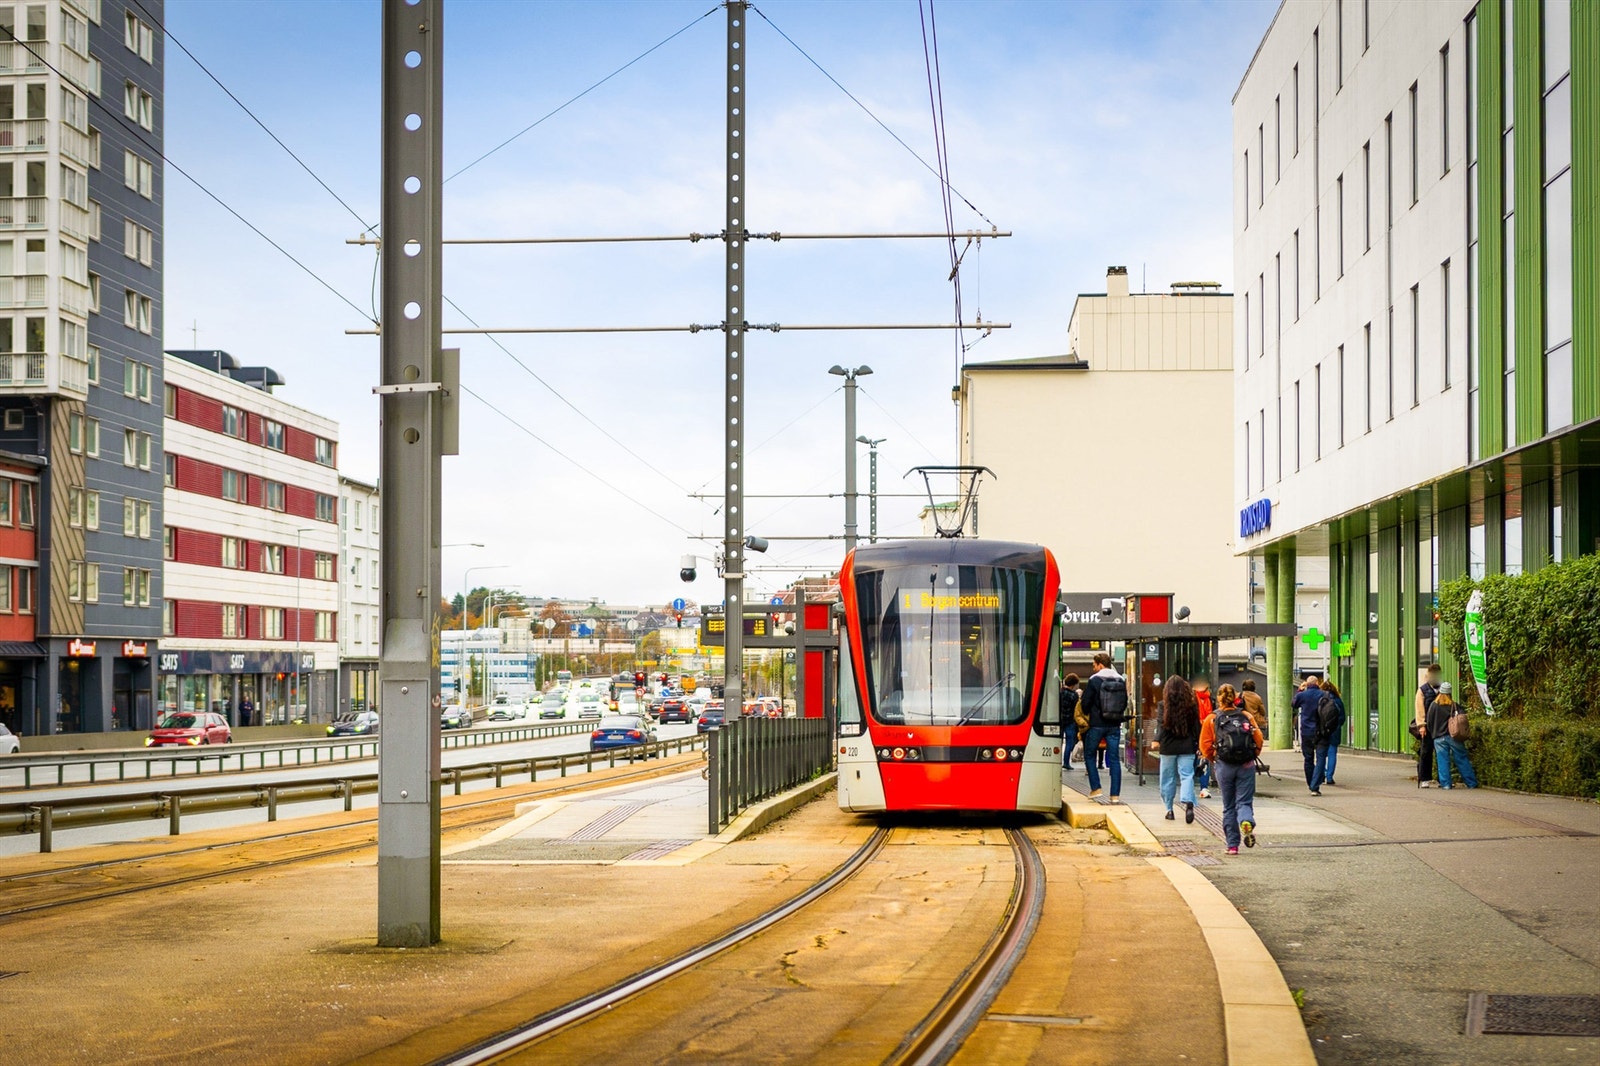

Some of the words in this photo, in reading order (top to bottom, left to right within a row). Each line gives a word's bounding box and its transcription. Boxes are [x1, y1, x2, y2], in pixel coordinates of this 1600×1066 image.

[904, 594, 911, 609] 1
[161, 654, 179, 671] SATS
[230, 654, 245, 669] SATS
[302, 654, 314, 669] SATS
[848, 747, 859, 757] 220
[1042, 747, 1052, 757] 220
